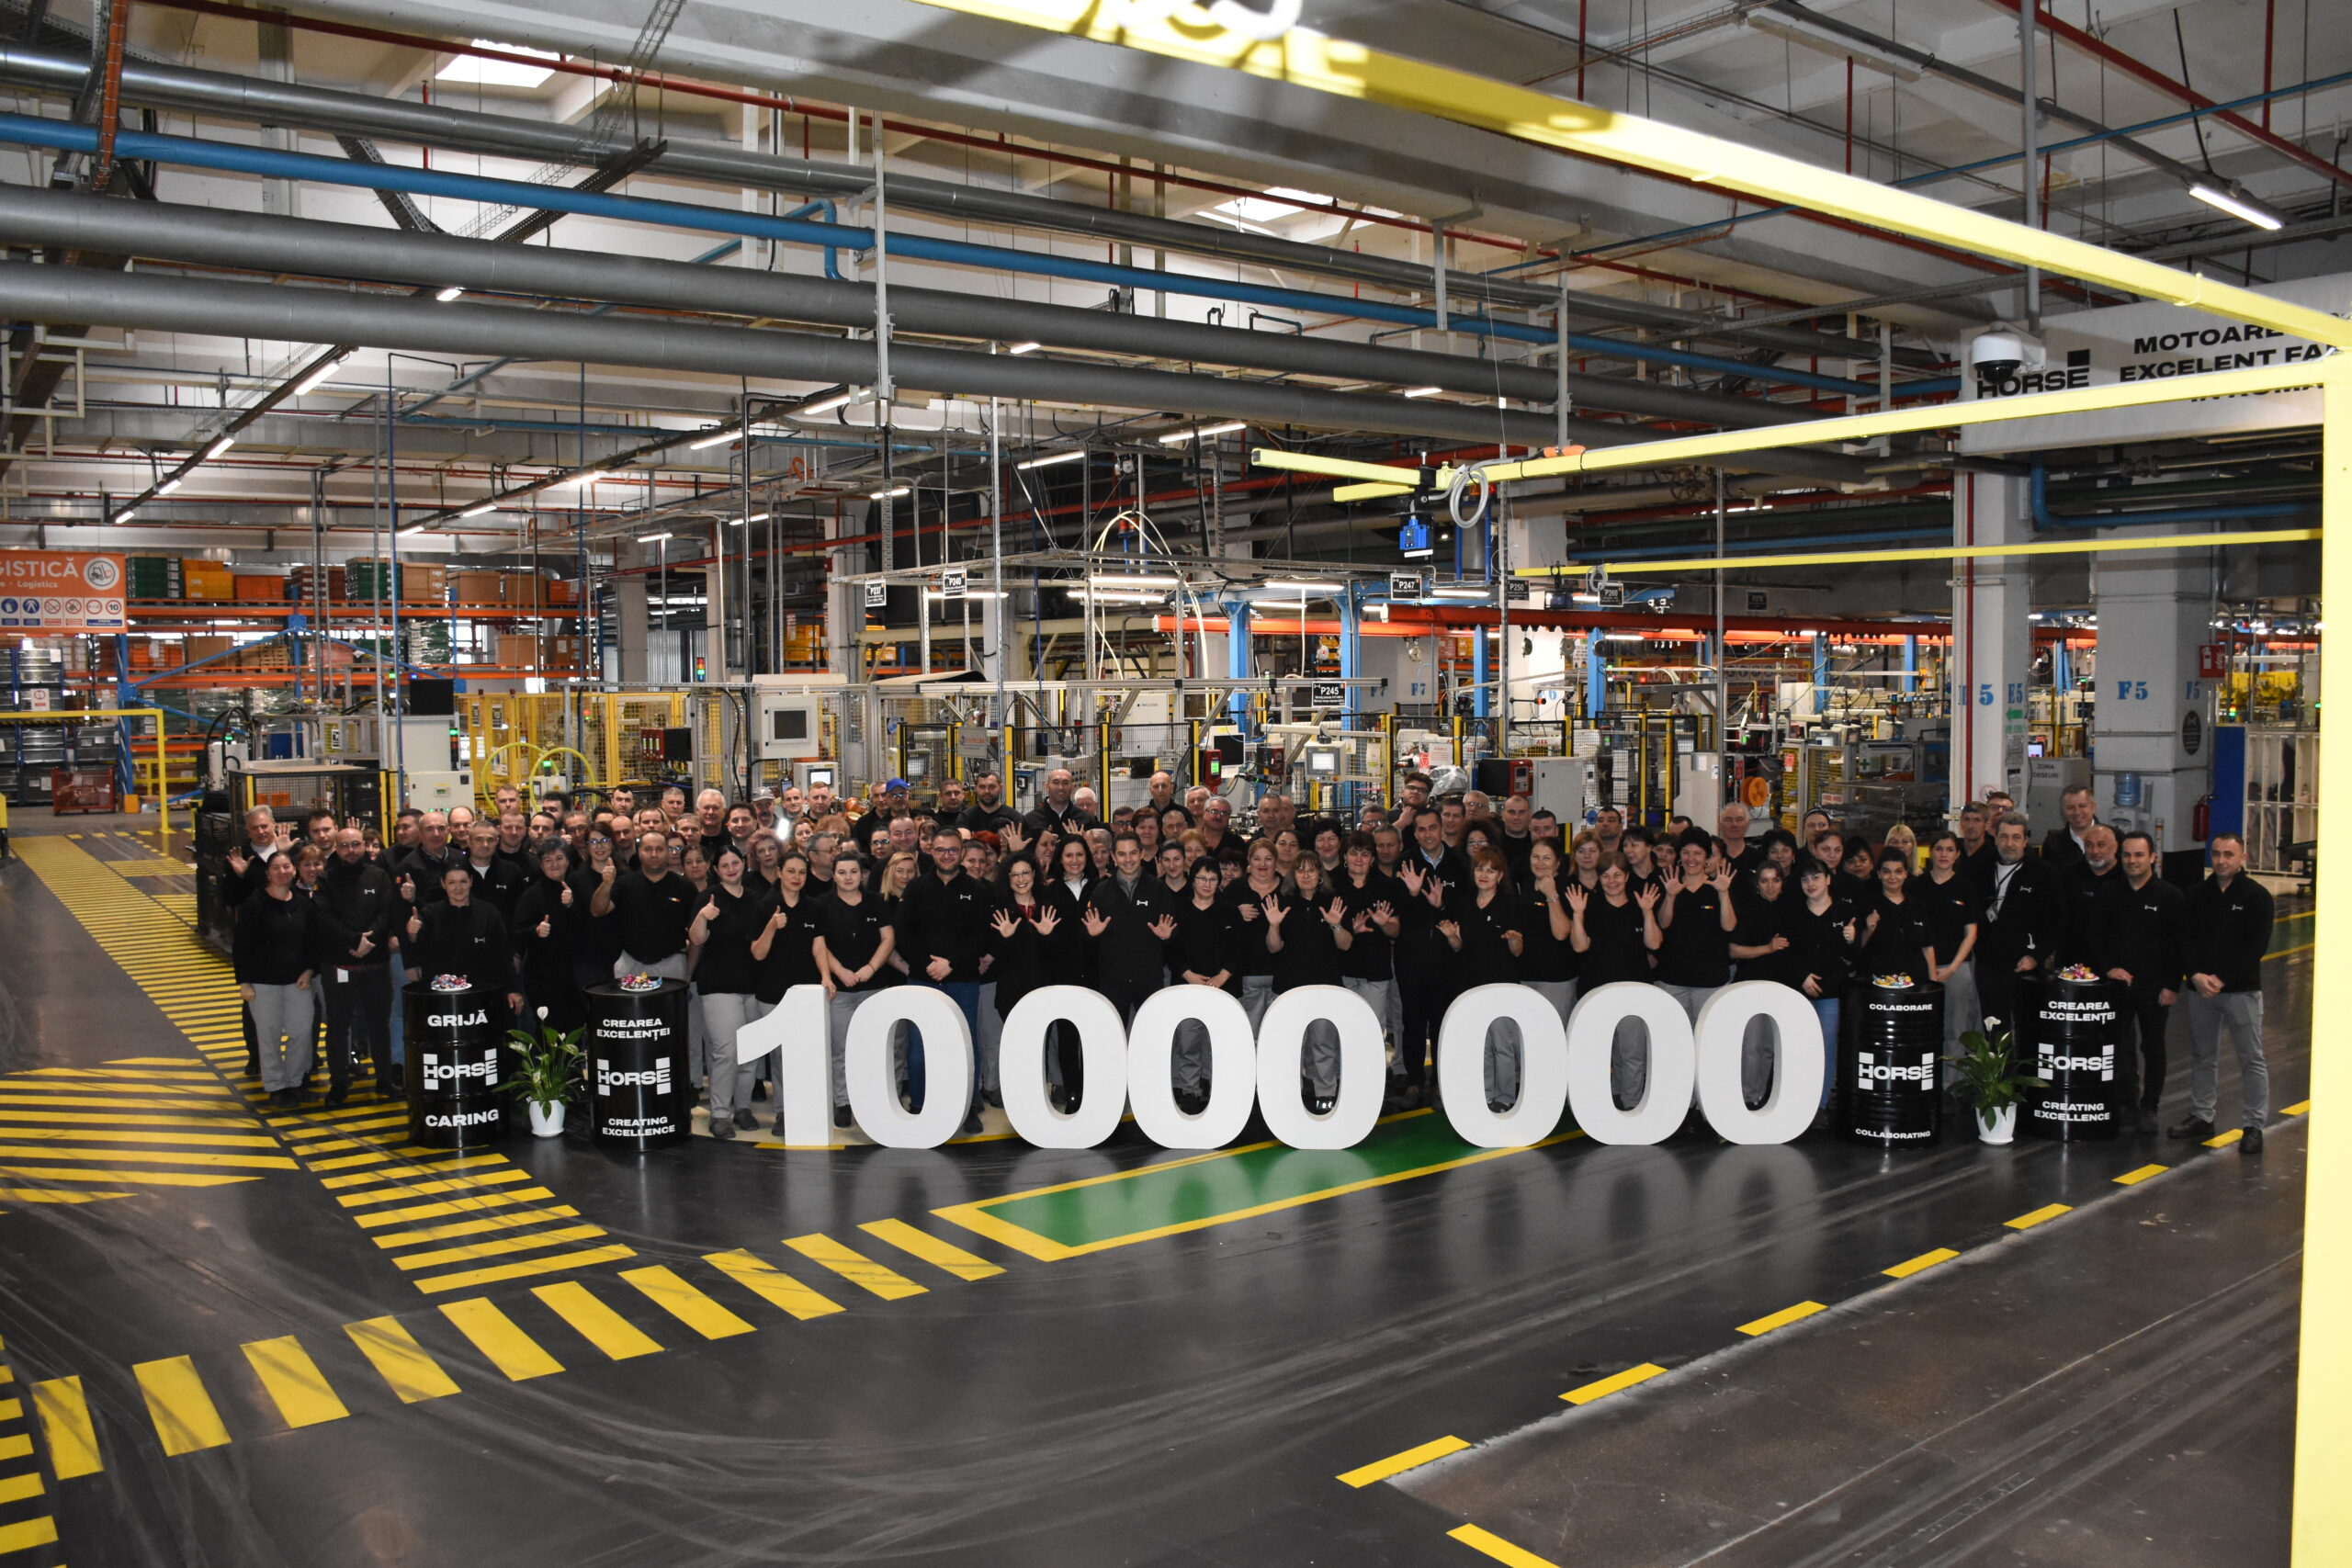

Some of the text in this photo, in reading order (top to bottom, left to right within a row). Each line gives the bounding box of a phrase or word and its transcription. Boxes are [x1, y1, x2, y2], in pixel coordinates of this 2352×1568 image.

[2119, 349, 2277, 383] EXCELENT
[1976, 367, 2090, 400] HORSE
[17, 581, 59, 589] Logistics
[1398, 581, 1415, 589] P247
[1320, 686, 1340, 695] P245
[1411, 682, 1426, 696] F7
[2117, 681, 2149, 700] F5
[1869, 1003, 1933, 1011] COLABORARE
[2047, 1000, 2110, 1011] CREAREA
[427, 1009, 489, 1027] GRIJĂ
[602, 1018, 663, 1028] CREAREA
[736, 979, 1826, 1149] 10 000 000
[2038, 1053, 2114, 1071] HORSE
[423, 1059, 498, 1080] HORSE
[1858, 1063, 1934, 1081] HORSE
[596, 1068, 672, 1086] HORSE
[2041, 1100, 2105, 1111] CREATING
[424, 1109, 500, 1127] CARING
[608, 1116, 669, 1127] CREATING
[2033, 1109, 2111, 1122] EXCELLENCE
[602, 1124, 676, 1137] EXCELLENCE
[1855, 1128, 1932, 1140] COLLABORATING
